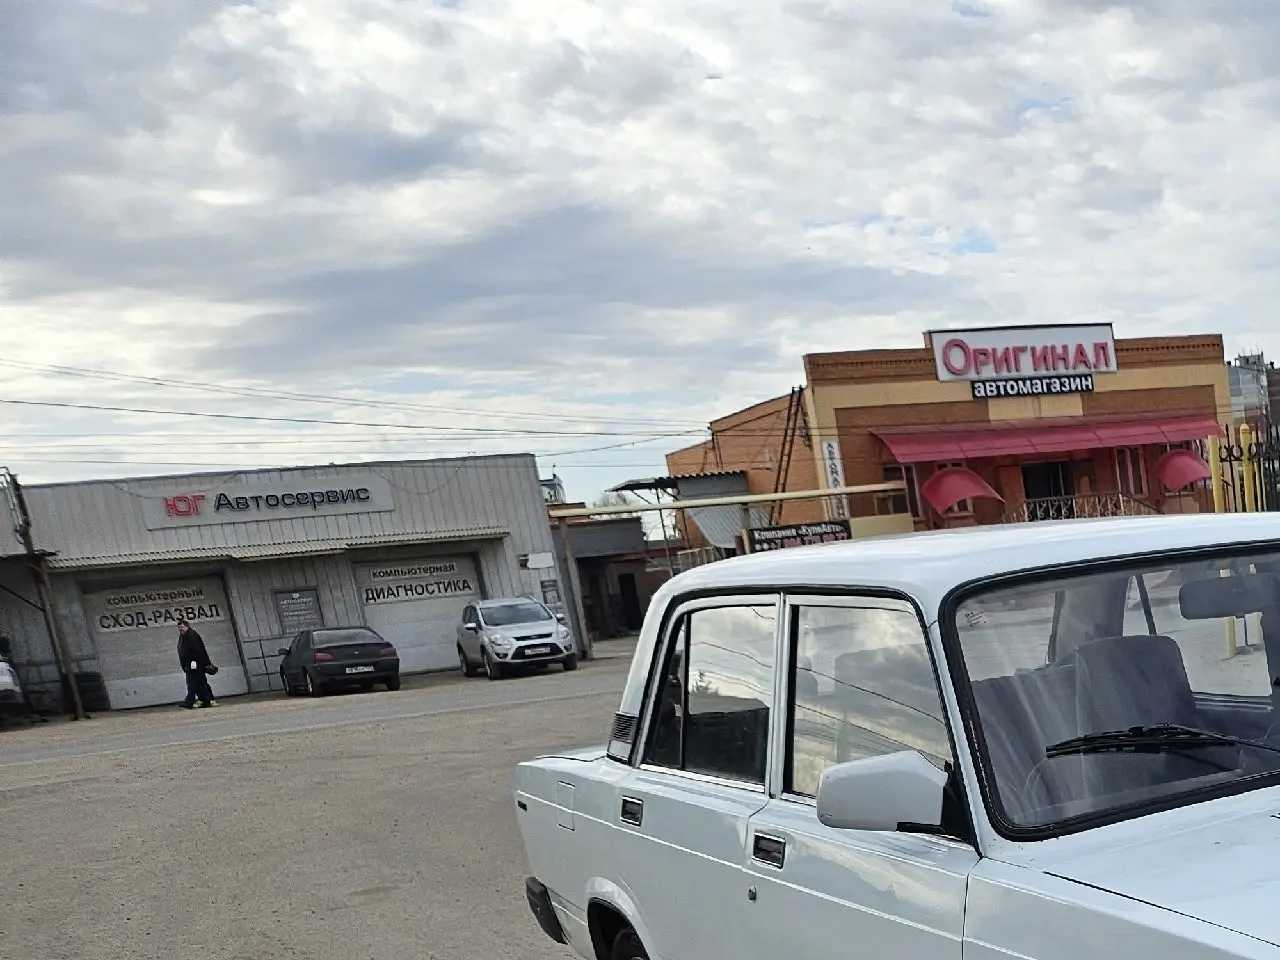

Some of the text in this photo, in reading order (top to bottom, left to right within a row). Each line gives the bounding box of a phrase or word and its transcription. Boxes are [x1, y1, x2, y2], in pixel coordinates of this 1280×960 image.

[973, 375, 1094, 398] автомагазин
[163, 487, 371, 517] ЮГ Автосервис
[371, 563, 456, 579] компьютерная
[364, 579, 473, 603] ДИАГНОСТИКА
[99, 603, 221, 629] СХОД-РАЗВАЛ
